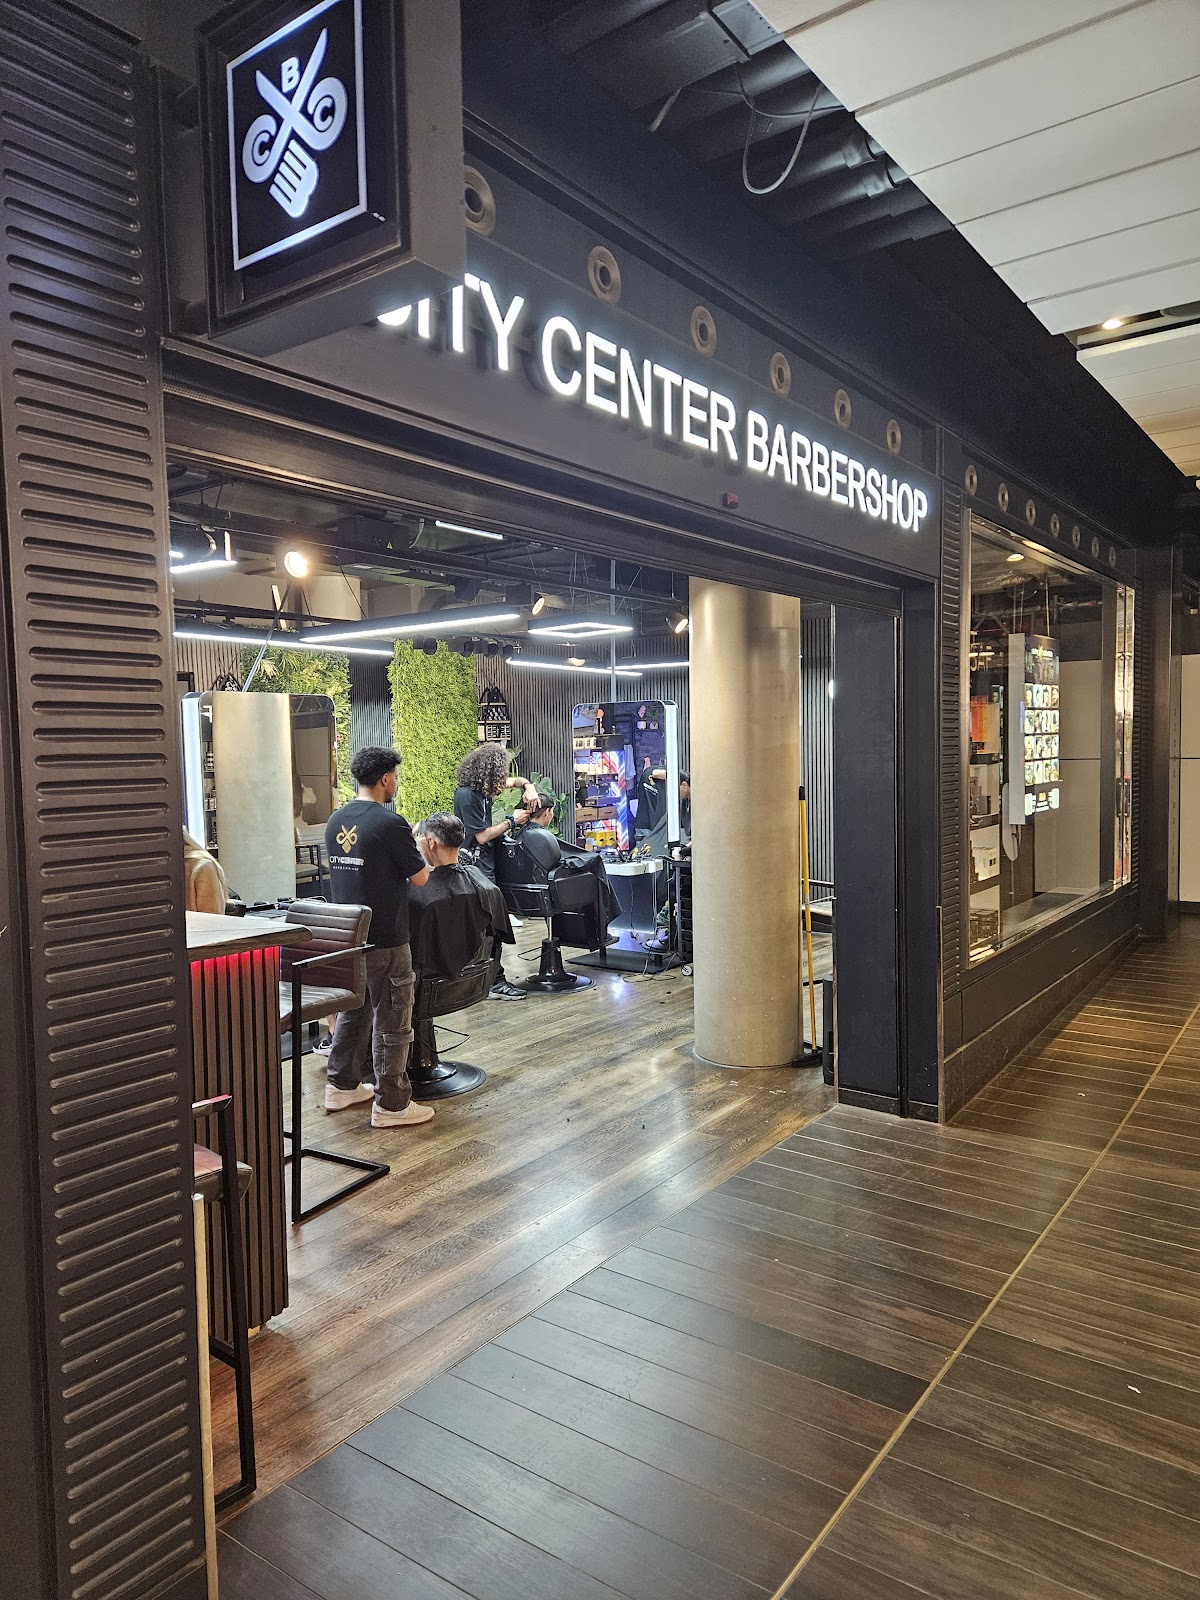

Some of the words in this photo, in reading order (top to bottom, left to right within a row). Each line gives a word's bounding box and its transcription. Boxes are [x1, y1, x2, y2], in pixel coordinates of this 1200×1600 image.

[281, 56, 300, 94] B
[541, 316, 739, 461] CENTER
[747, 409, 928, 533] BARBERSHOP
